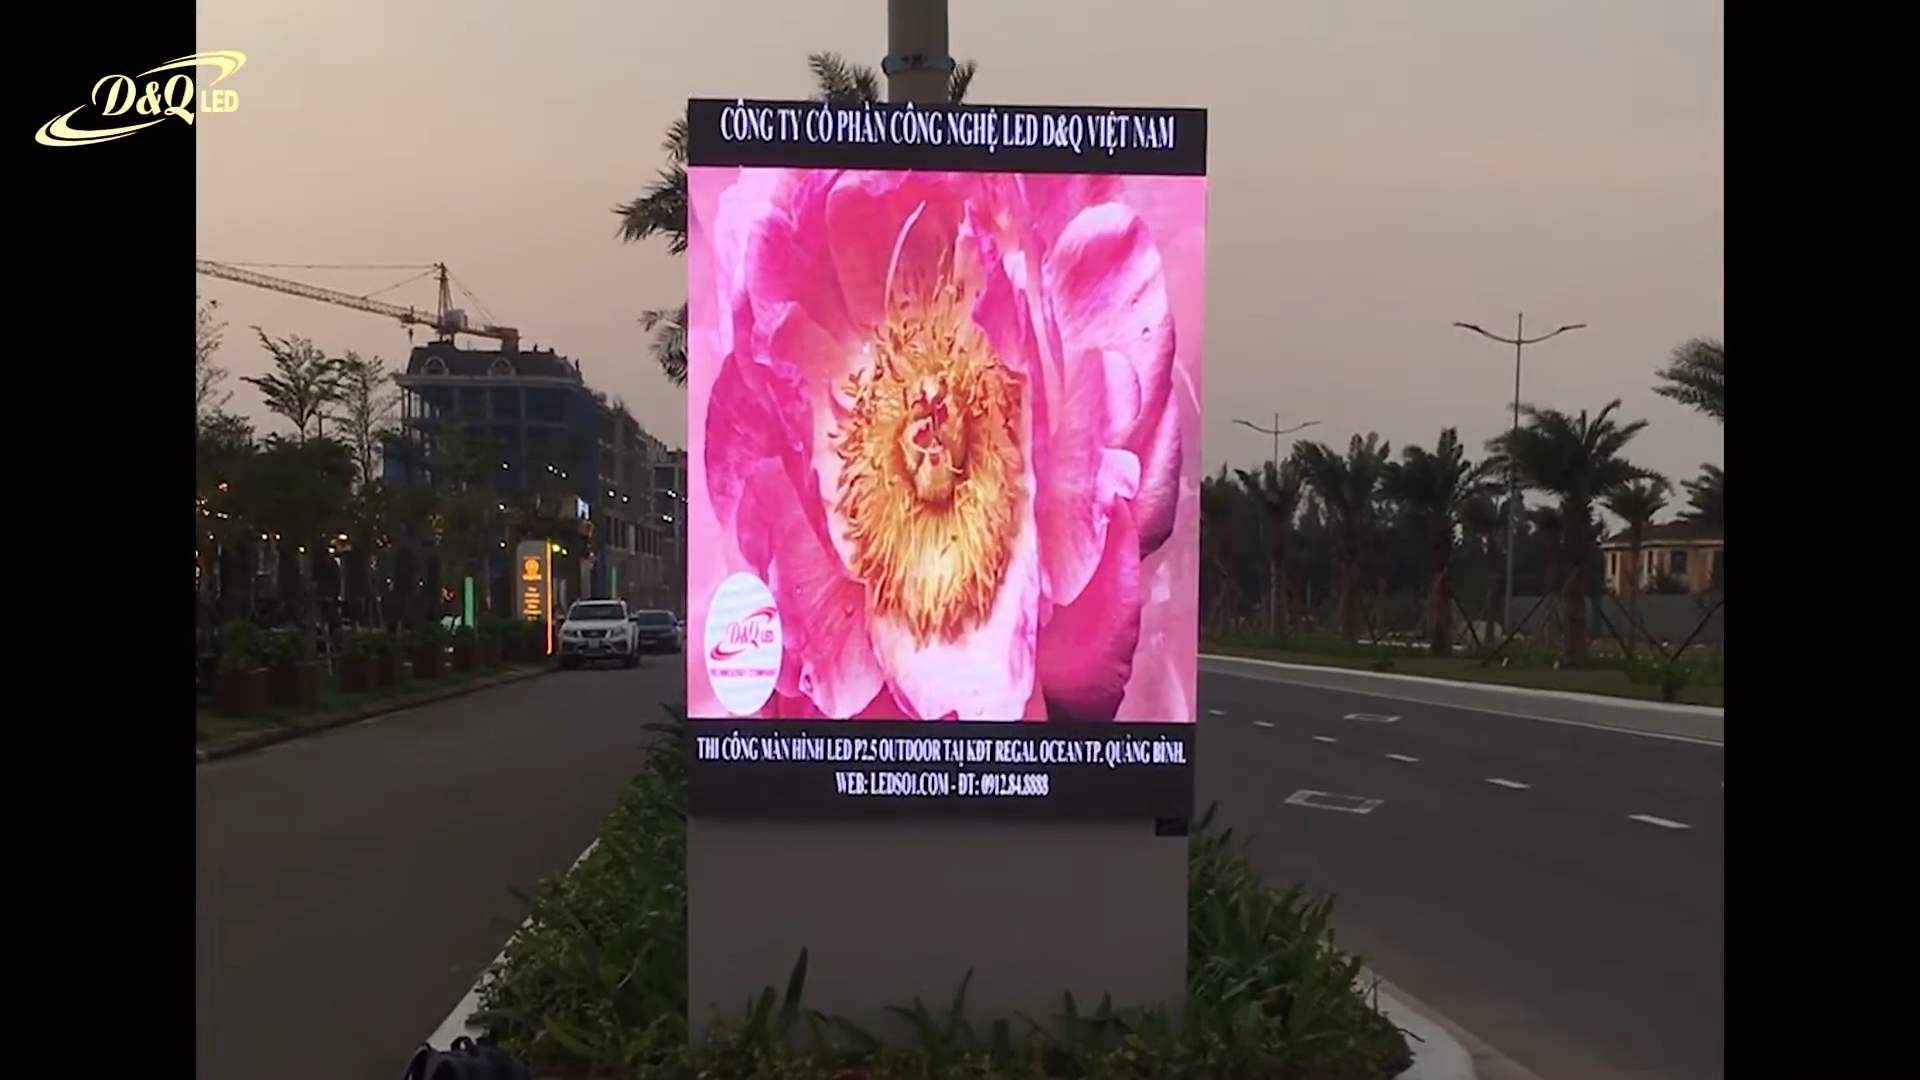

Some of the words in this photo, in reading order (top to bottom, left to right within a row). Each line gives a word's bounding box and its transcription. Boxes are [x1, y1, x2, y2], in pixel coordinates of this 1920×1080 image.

[720, 98, 774, 141] CÔNG
[777, 108, 801, 141] TY
[890, 101, 943, 145] CÔNG
[947, 107, 999, 153] NGHỆ
[1002, 113, 1039, 147] LED
[1042, 114, 1082, 153] D&Q
[1086, 110, 1129, 155] VIỆT
[1132, 116, 1176, 148] NAM
[727, 620, 760, 649] D&Q
[697, 737, 719, 760] THI
[827, 738, 853, 761] LED
[879, 738, 941, 762] OUTDOOR
[995, 740, 1038, 763] REGAL
[1039, 740, 1084, 763] OCEAN
[1085, 740, 1104, 763] TP.
[835, 772, 869, 794] WEB:
